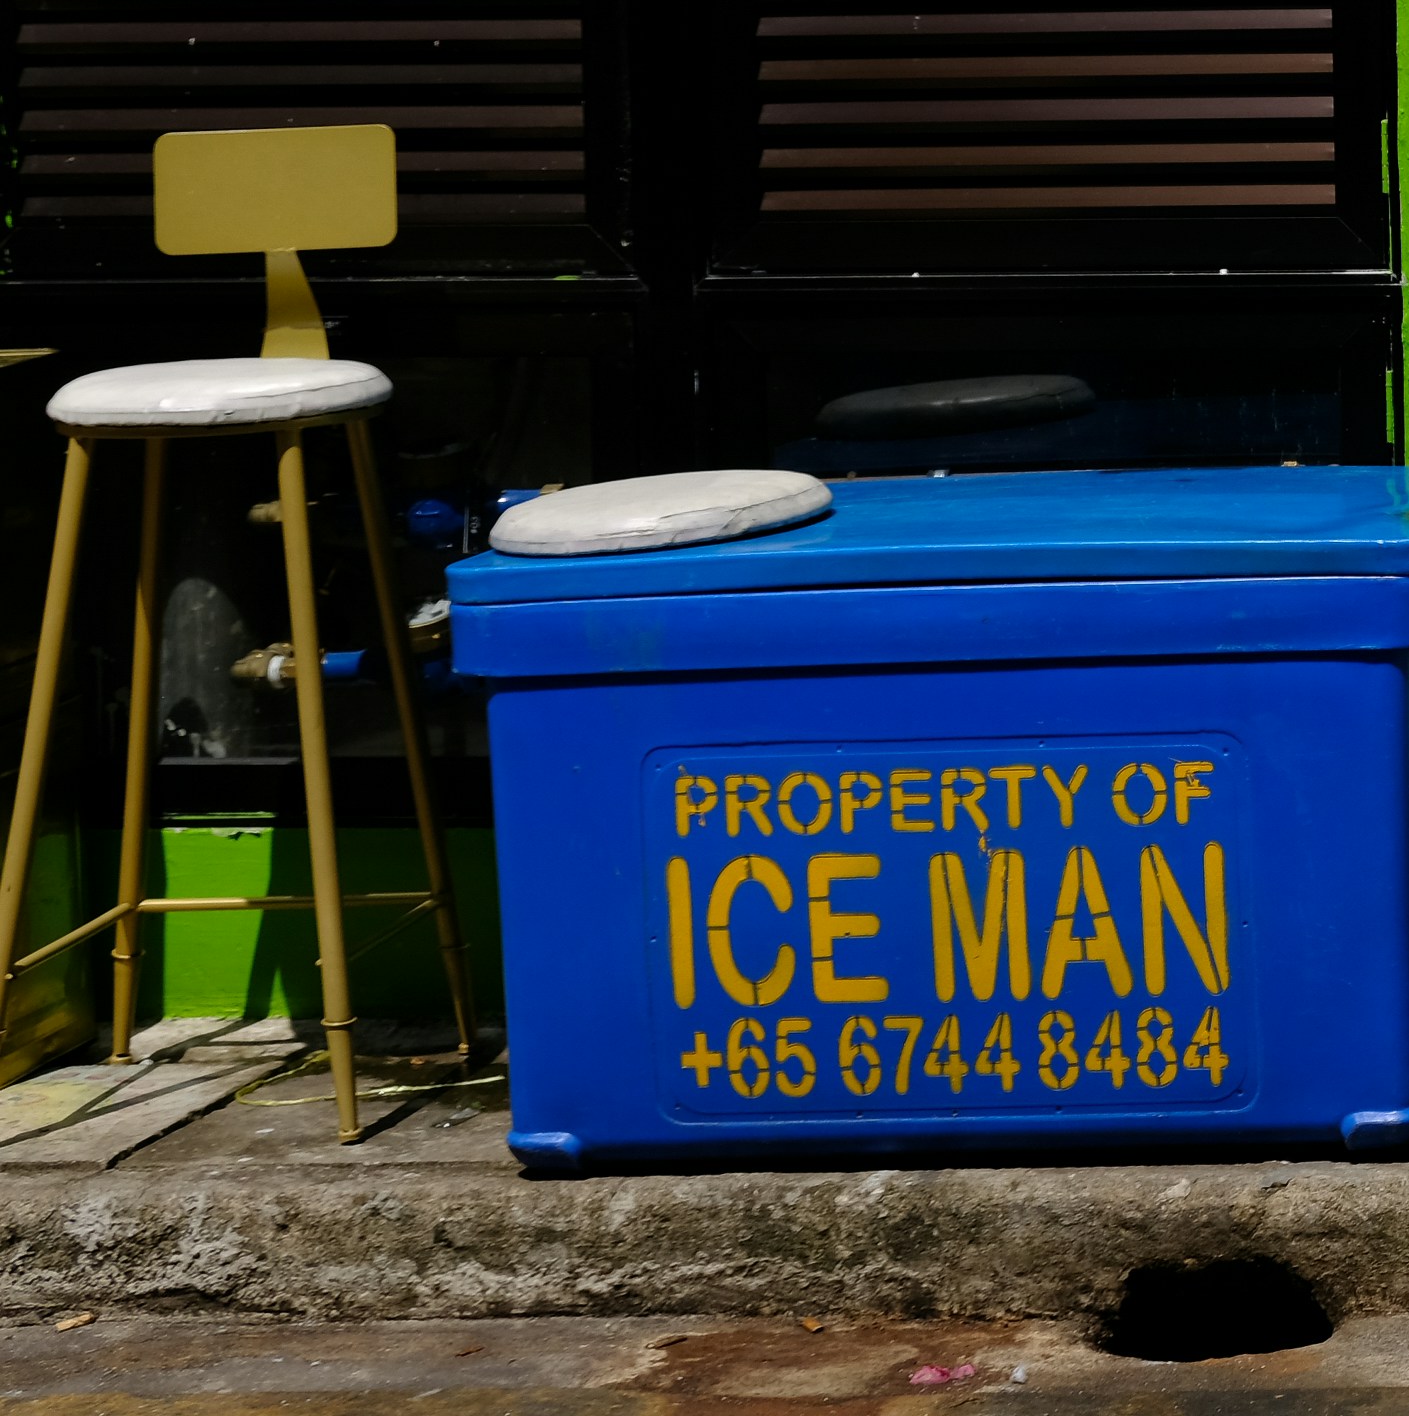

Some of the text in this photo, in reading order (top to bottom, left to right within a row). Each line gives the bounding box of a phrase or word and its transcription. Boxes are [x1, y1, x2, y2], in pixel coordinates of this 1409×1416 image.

[674, 760, 1215, 837] PROPERTY OF
[666, 841, 1230, 1010] ICE MAN
[681, 1006, 1230, 1099] +65 6744 8484
